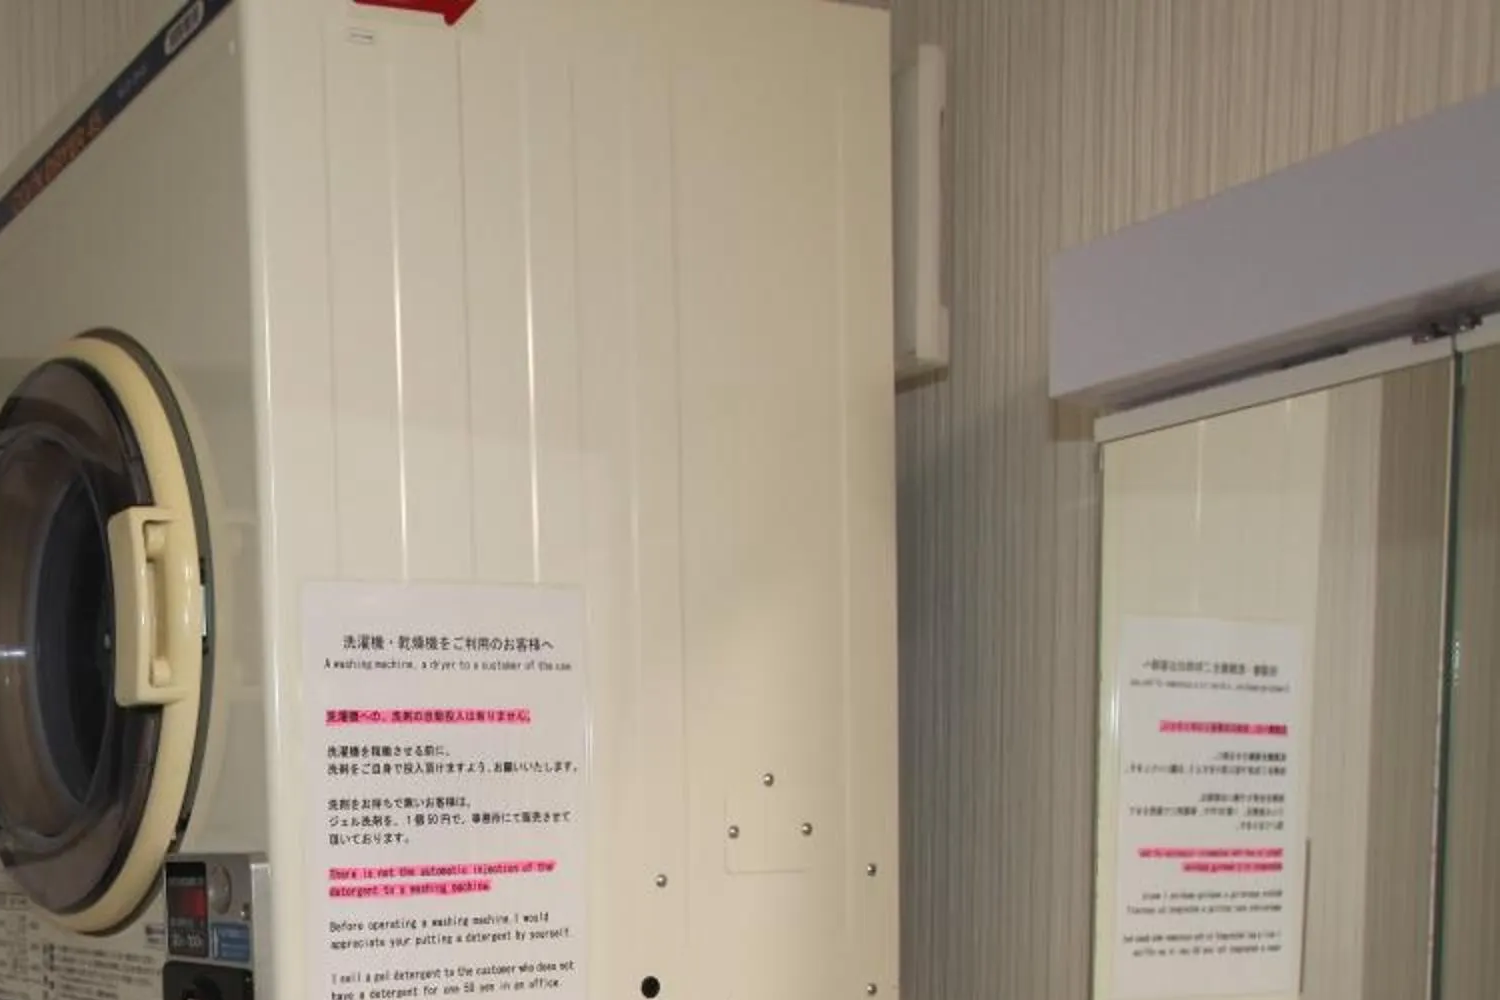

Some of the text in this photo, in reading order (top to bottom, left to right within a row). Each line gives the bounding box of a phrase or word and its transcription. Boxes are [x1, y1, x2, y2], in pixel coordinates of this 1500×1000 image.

[333, 658, 372, 670] washing
[430, 659, 454, 671] dryer
[459, 660, 471, 670] to
[525, 660, 535, 670] of
[538, 661, 553, 671] the
[363, 868, 373, 878] is
[378, 867, 394, 878] not
[399, 866, 415, 877] the
[421, 864, 467, 877] automatic
[521, 861, 533, 873] of
[329, 885, 378, 897] detergent
[384, 884, 395, 894] to
[411, 883, 447, 895] washing
[329, 920, 364, 933] Before
[368, 918, 417, 931] operating
[432, 915, 468, 927] washing
[523, 911, 549, 923] would
[330, 938, 385, 950] appreciate
[389, 937, 411, 949] your
[415, 934, 453, 946] putting
[466, 931, 511, 943] detergent
[515, 929, 526, 941] by
[394, 967, 441, 980] detergent
[444, 967, 454, 977] to
[457, 966, 473, 977] the
[476, 964, 517, 975] customer
[518, 962, 535, 973] who
[536, 961, 557, 972] does
[559, 959, 574, 971] not
[331, 991, 355, 1000] have
[369, 986, 418, 999] detergent
[423, 985, 438, 997] for
[443, 986, 460, 996] one
[480, 982, 495, 994] yen
